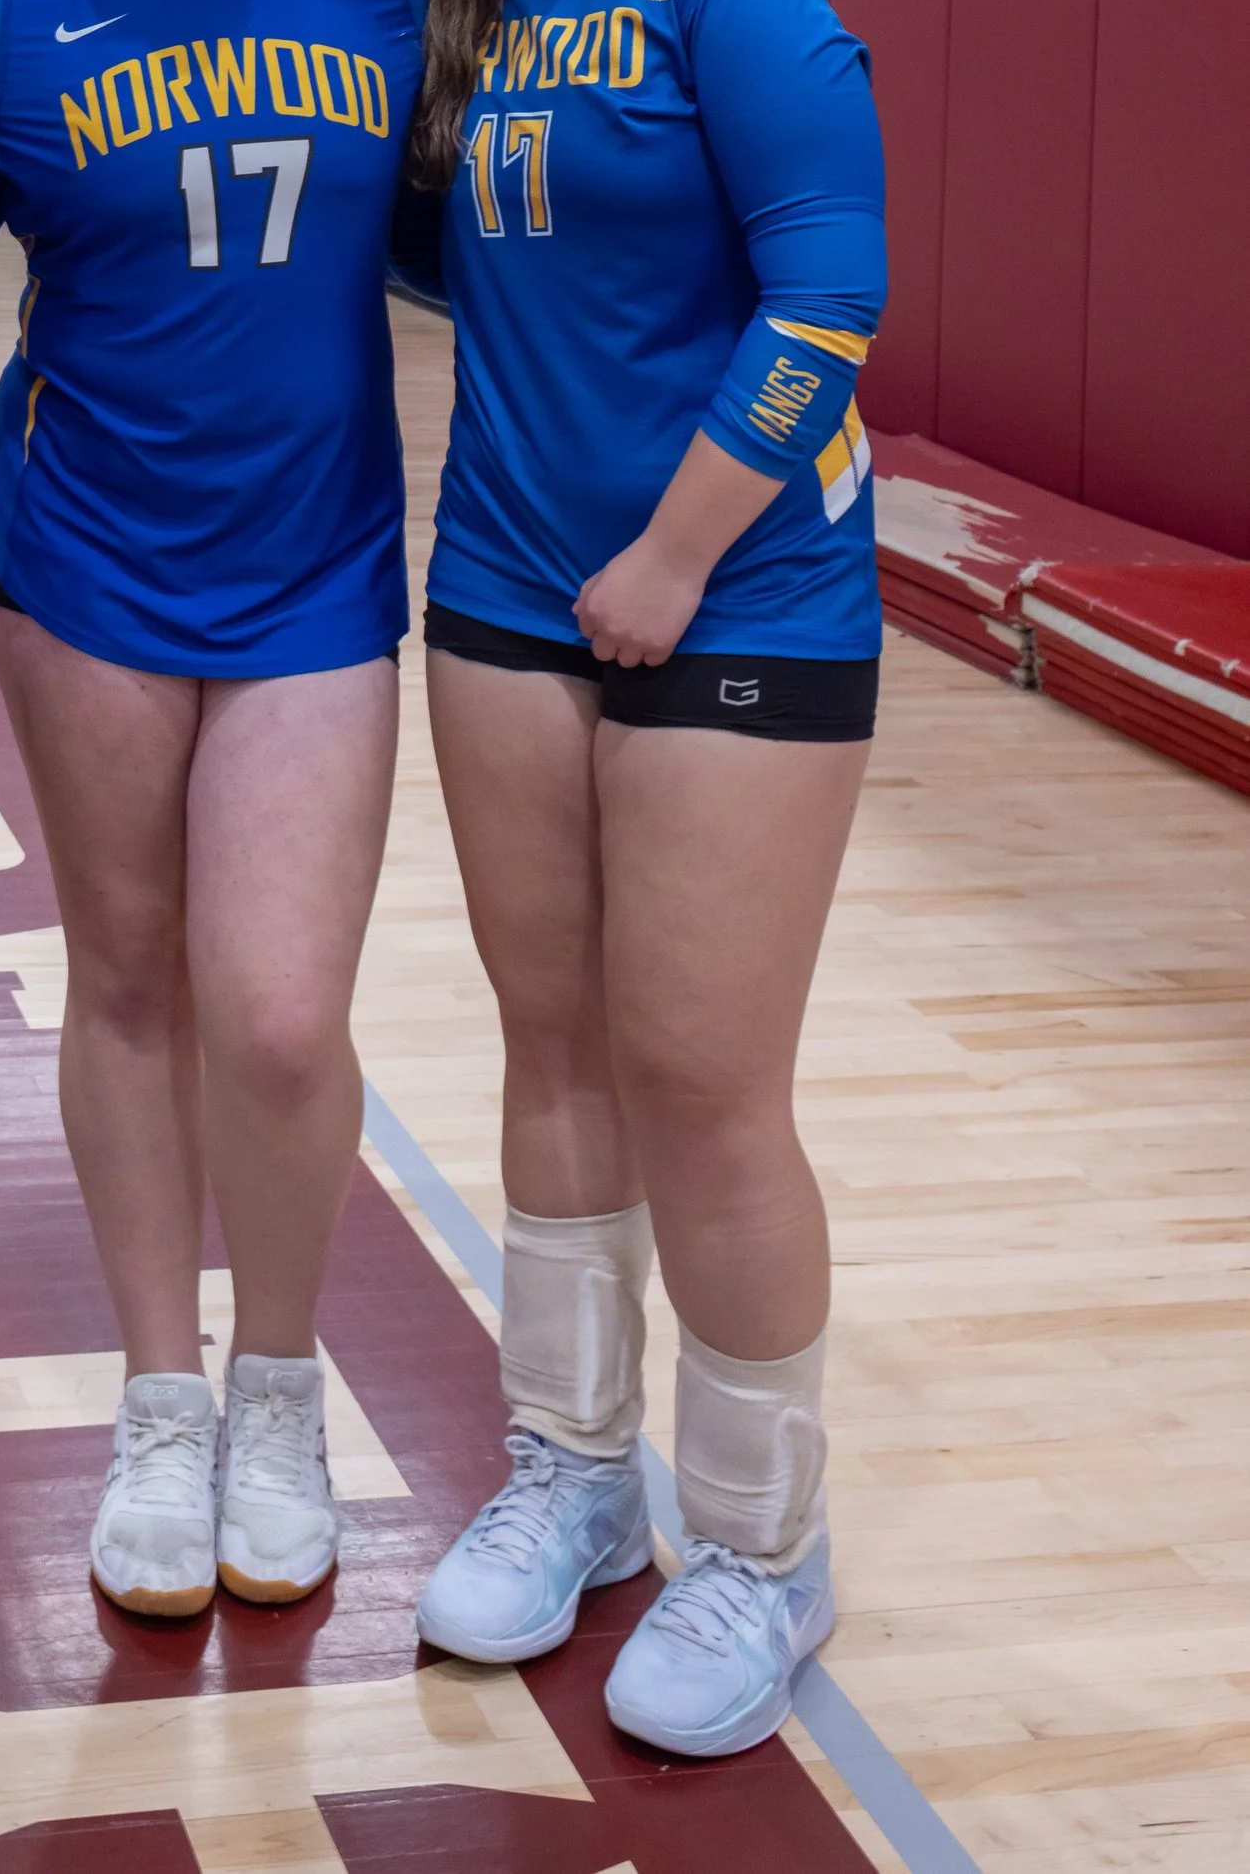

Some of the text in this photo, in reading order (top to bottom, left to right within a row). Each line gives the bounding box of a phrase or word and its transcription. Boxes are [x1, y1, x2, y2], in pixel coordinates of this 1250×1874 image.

[60, 36, 390, 171] NORWOOD
[179, 135, 313, 271] 17
[463, 110, 554, 238] 17
